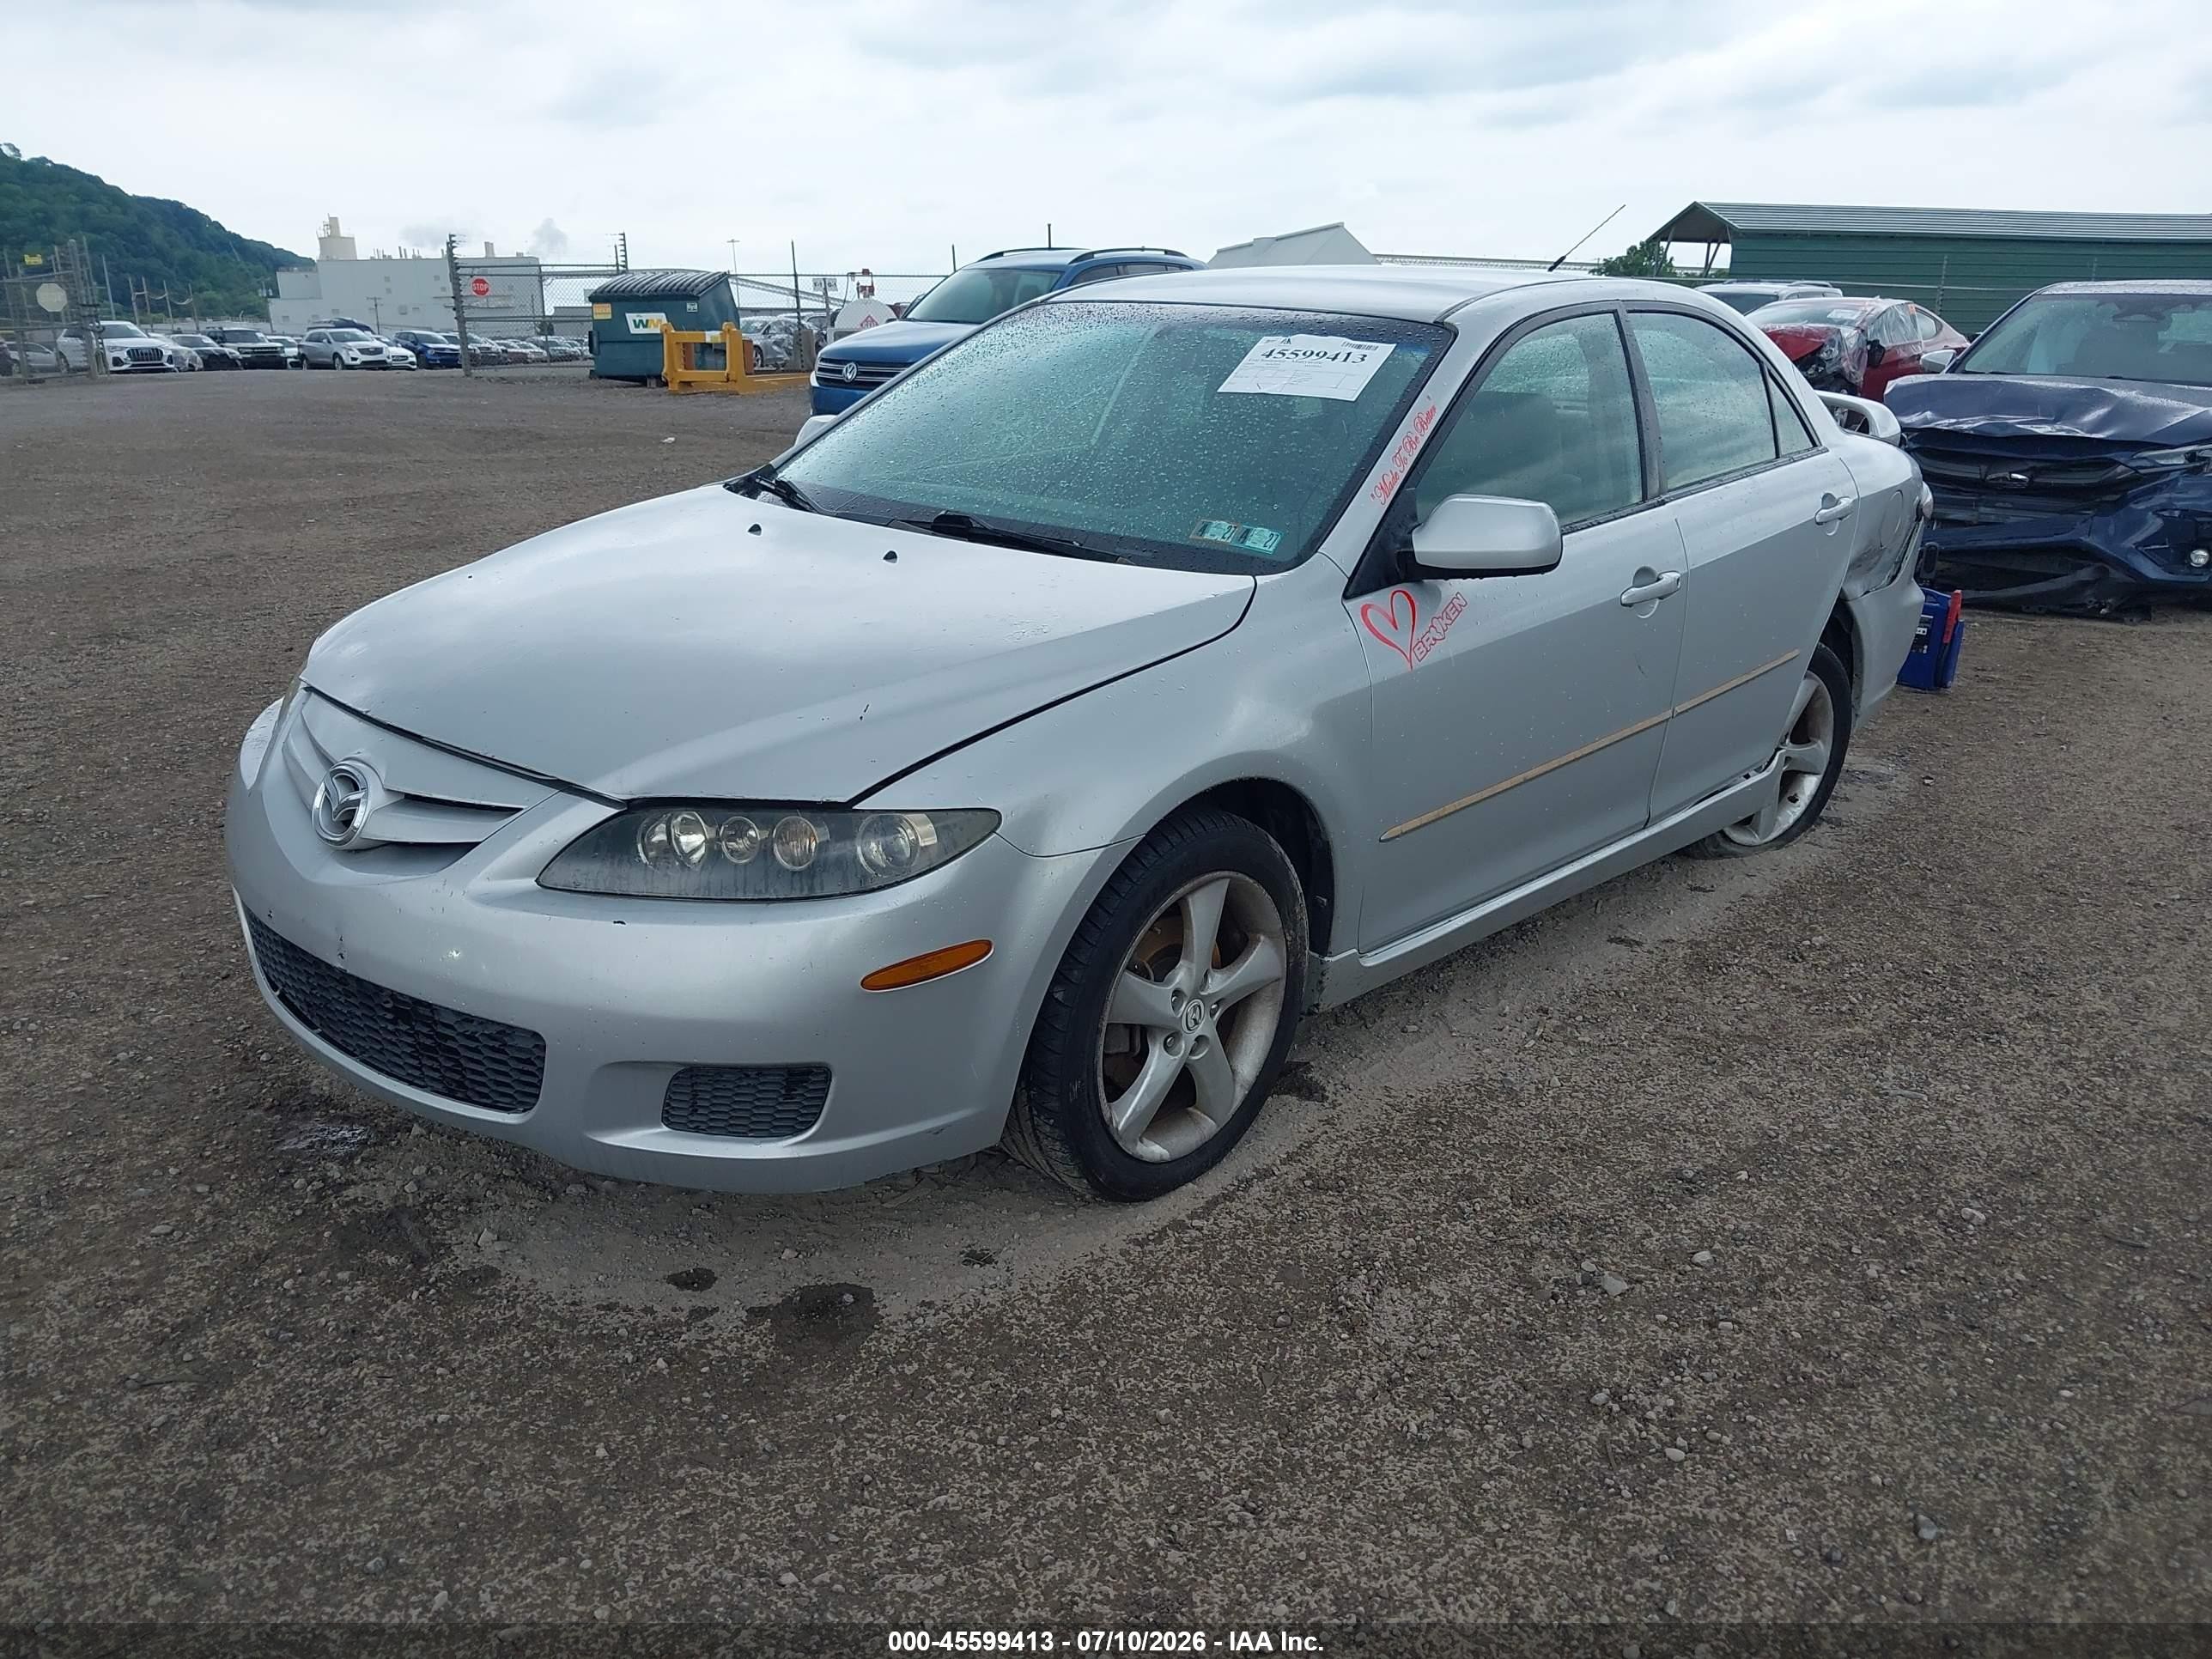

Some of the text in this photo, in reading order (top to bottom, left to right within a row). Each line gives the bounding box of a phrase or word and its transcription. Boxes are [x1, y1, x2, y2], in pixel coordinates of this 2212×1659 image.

[1261, 348, 1368, 364] 45599413
[1392, 445, 1408, 473] To
[1402, 431, 1420, 456] Be
